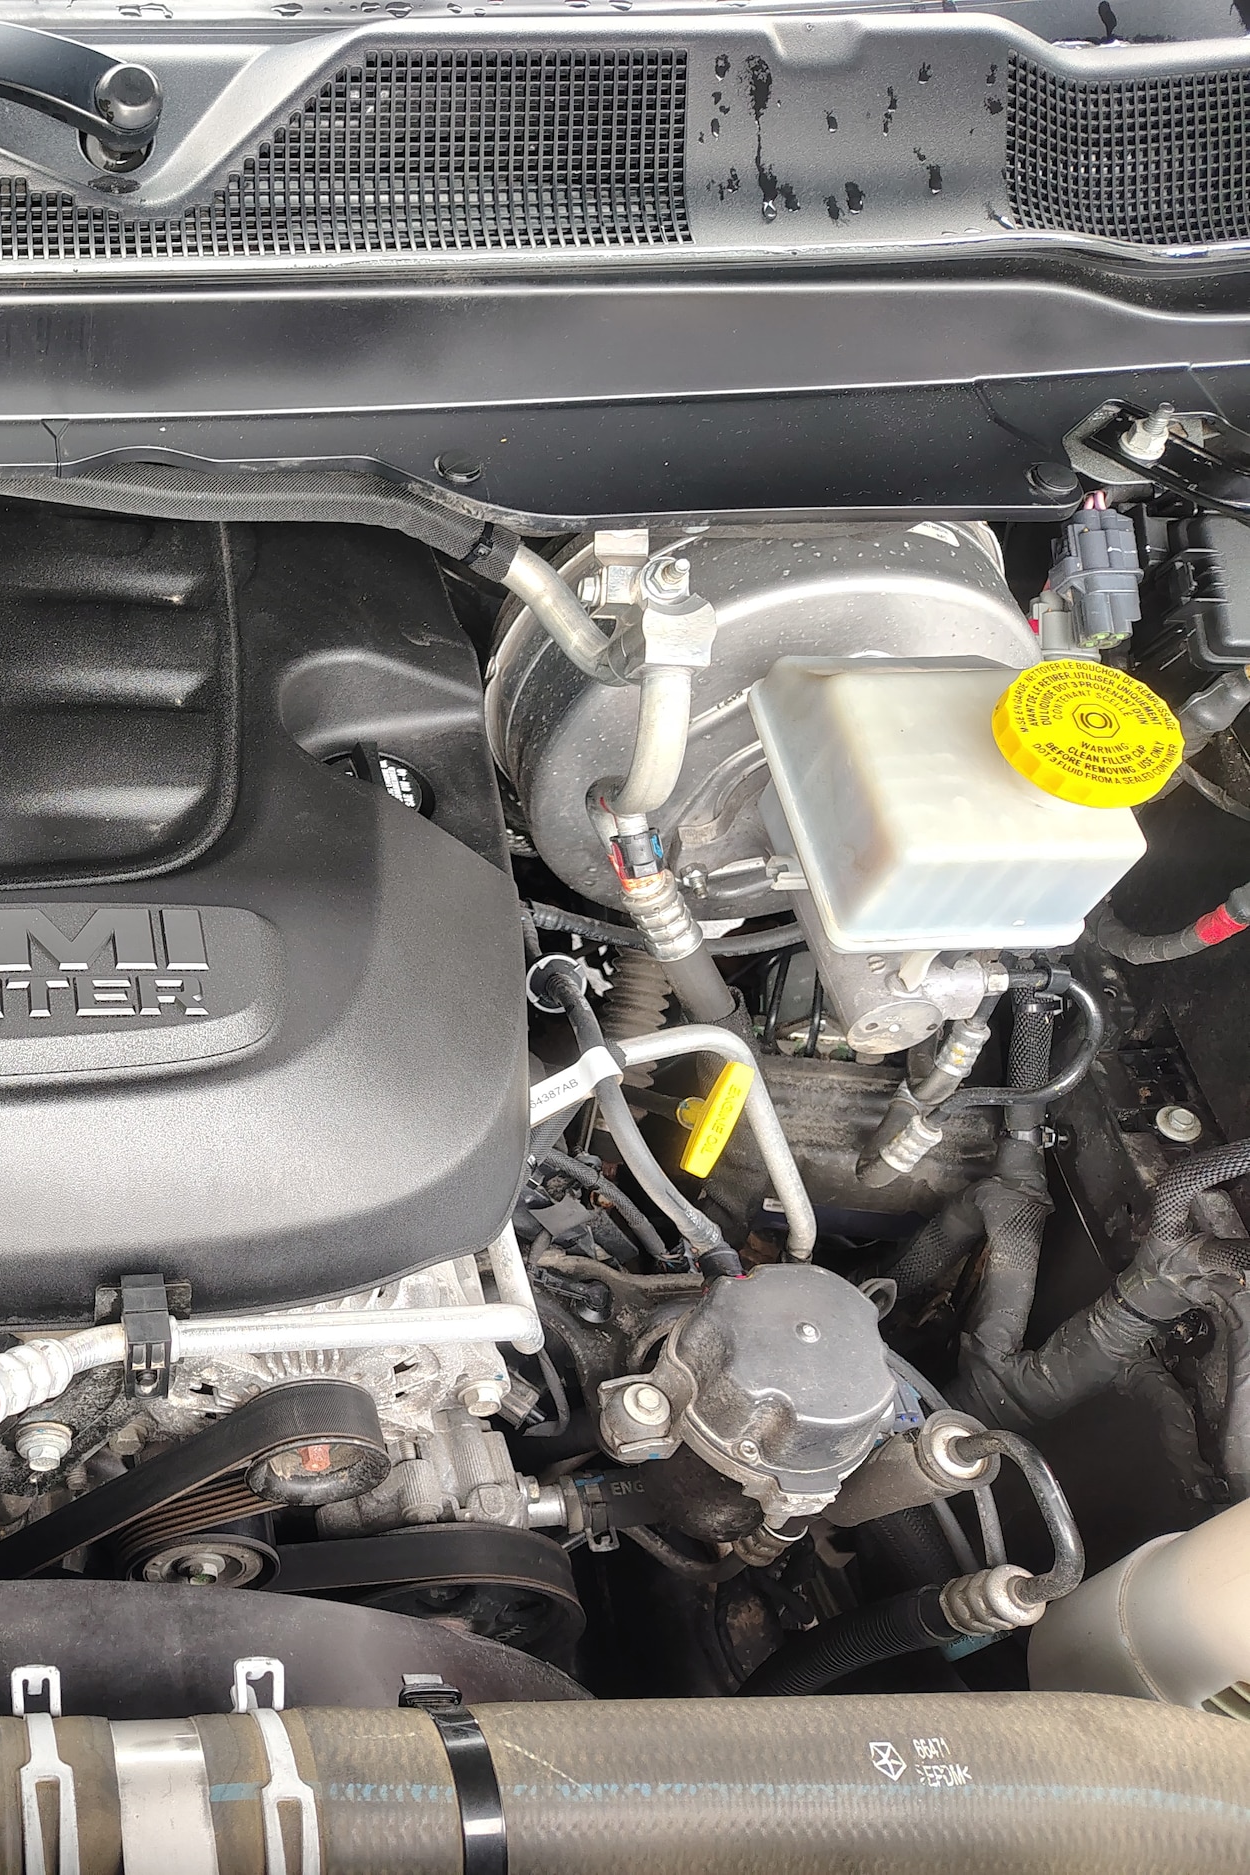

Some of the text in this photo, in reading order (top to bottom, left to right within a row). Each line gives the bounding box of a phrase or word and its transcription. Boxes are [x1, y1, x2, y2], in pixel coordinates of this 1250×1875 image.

[1024, 663, 1062, 683] NETTOYER
[1062, 662, 1074, 670] LE
[1075, 662, 1121, 680] BOUCHON
[1122, 676, 1135, 687] DE
[1134, 684, 1178, 731] REMPLISSAGE
[1026, 703, 1039, 727] AVANT
[1073, 671, 1115, 687] UTILISER
[1116, 684, 1162, 726] UNIQUEMENT
[1052, 682, 1071, 693] DOT
[1078, 681, 1135, 709] PROVENANT
[1039, 689, 1057, 715] LIQUIDE
[1052, 690, 1091, 720] CONTENANT
[1039, 715, 1052, 726] DU
[1132, 708, 1149, 726] D'UN
[1032, 743, 1052, 758] DOT
[1050, 756, 1058, 764] 3
[1057, 760, 1084, 777] FLUID
[1085, 772, 1114, 784] FROM
[1122, 771, 1155, 785] SEALED
[1152, 743, 1180, 776] CONTAINER
[1045, 741, 1082, 767] BEFORE
[1137, 756, 1155, 770] USE
[1150, 740, 1165, 759] ONLY
[1067, 744, 1147, 765] CLEAN FILLER CAP
[700, 1083, 741, 1155] ENGINE OIL
[610, 1480, 645, 1496] ENG
[912, 1737, 951, 1760] 66471
